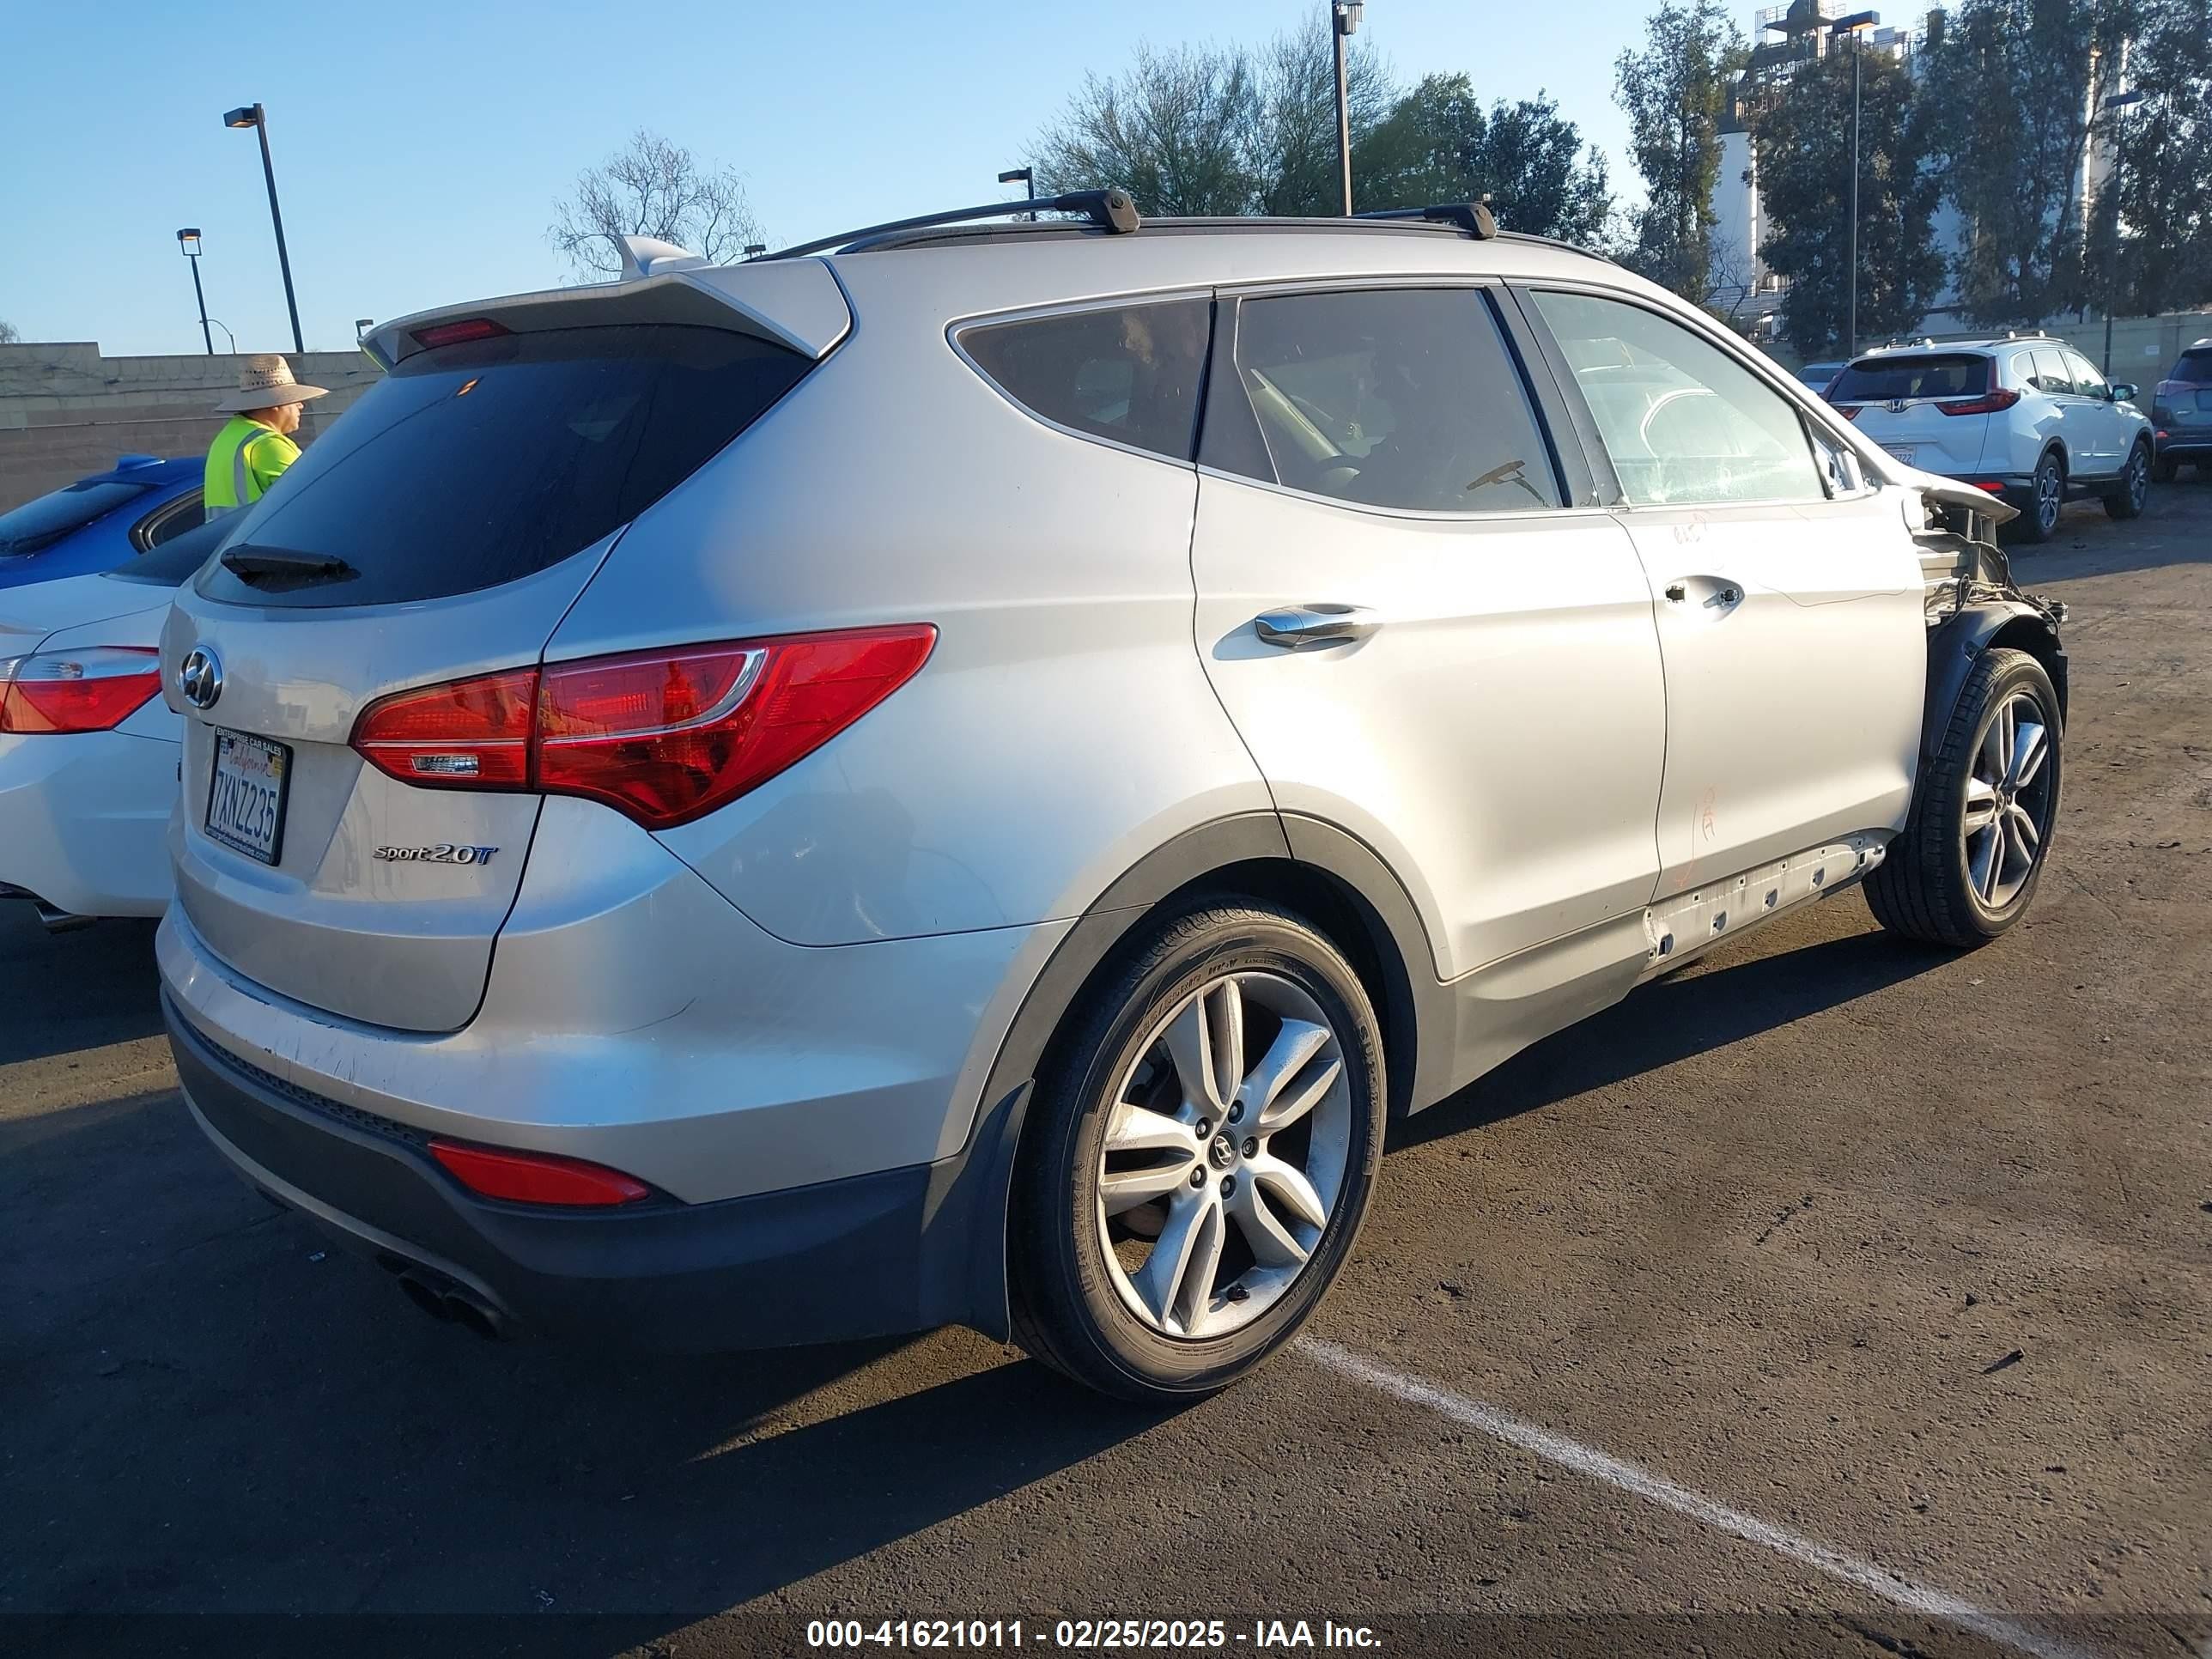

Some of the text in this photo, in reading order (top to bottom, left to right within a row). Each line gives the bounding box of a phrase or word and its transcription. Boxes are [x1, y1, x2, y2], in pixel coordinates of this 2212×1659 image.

[216, 727, 282, 757] ENTERPRISE CAR SALES
[229, 744, 272, 777] California
[214, 769, 276, 842] 7XNZ235
